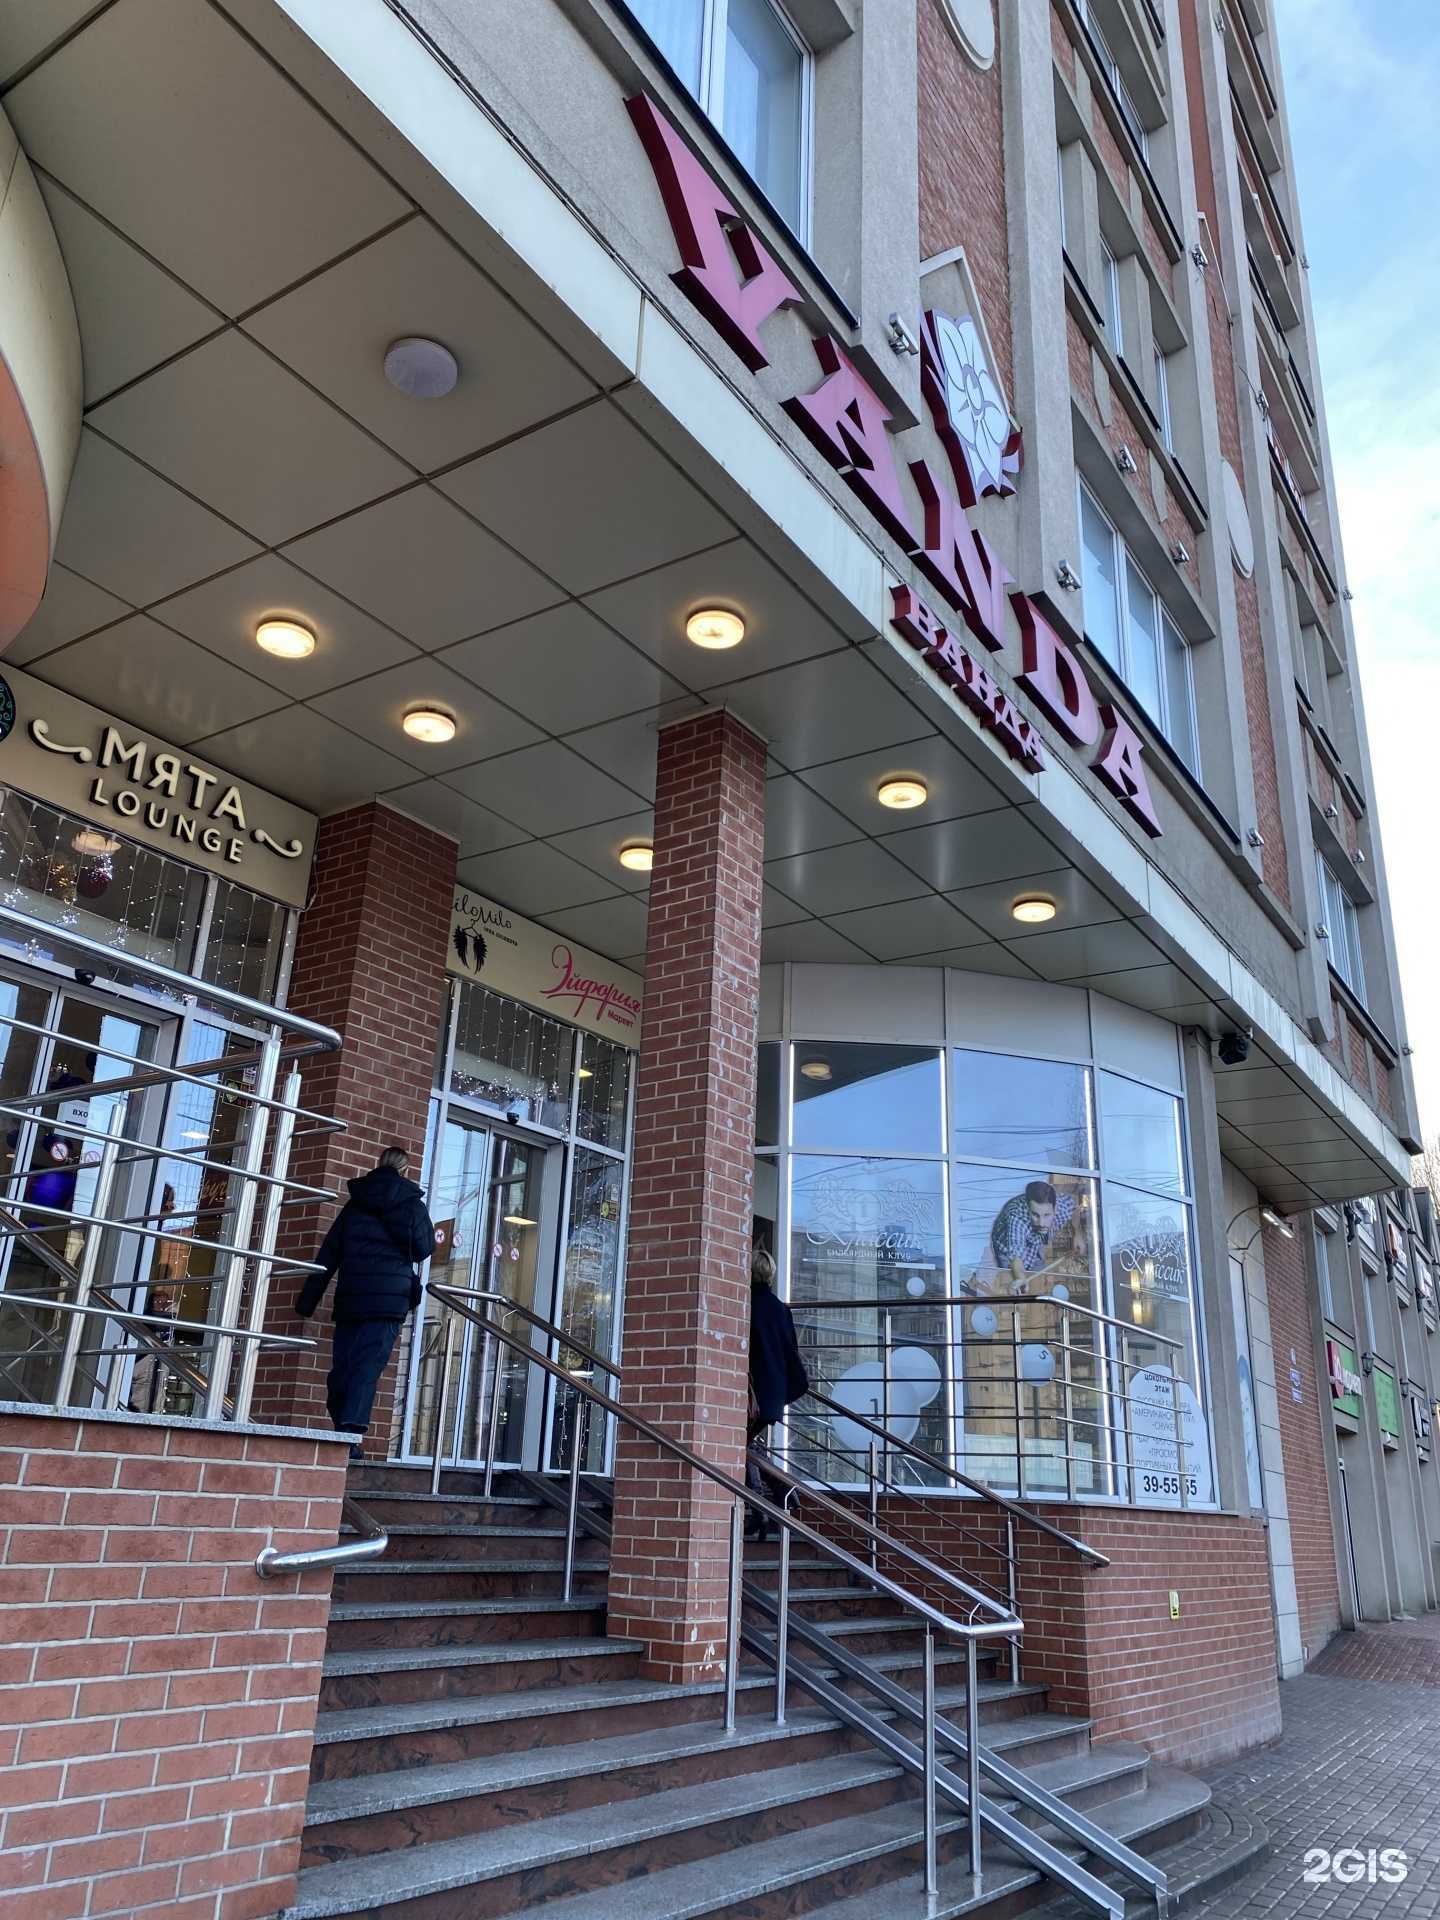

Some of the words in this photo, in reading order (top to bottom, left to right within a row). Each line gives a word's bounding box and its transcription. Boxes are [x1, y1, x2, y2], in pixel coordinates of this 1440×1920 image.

[624, 91, 1163, 838] VANDA
[890, 584, 1046, 774] ВАНДА
[89, 777, 244, 864] LOUNGE
[98, 726, 248, 831] МЯТА
[540, 944, 641, 1021] Эйфория
